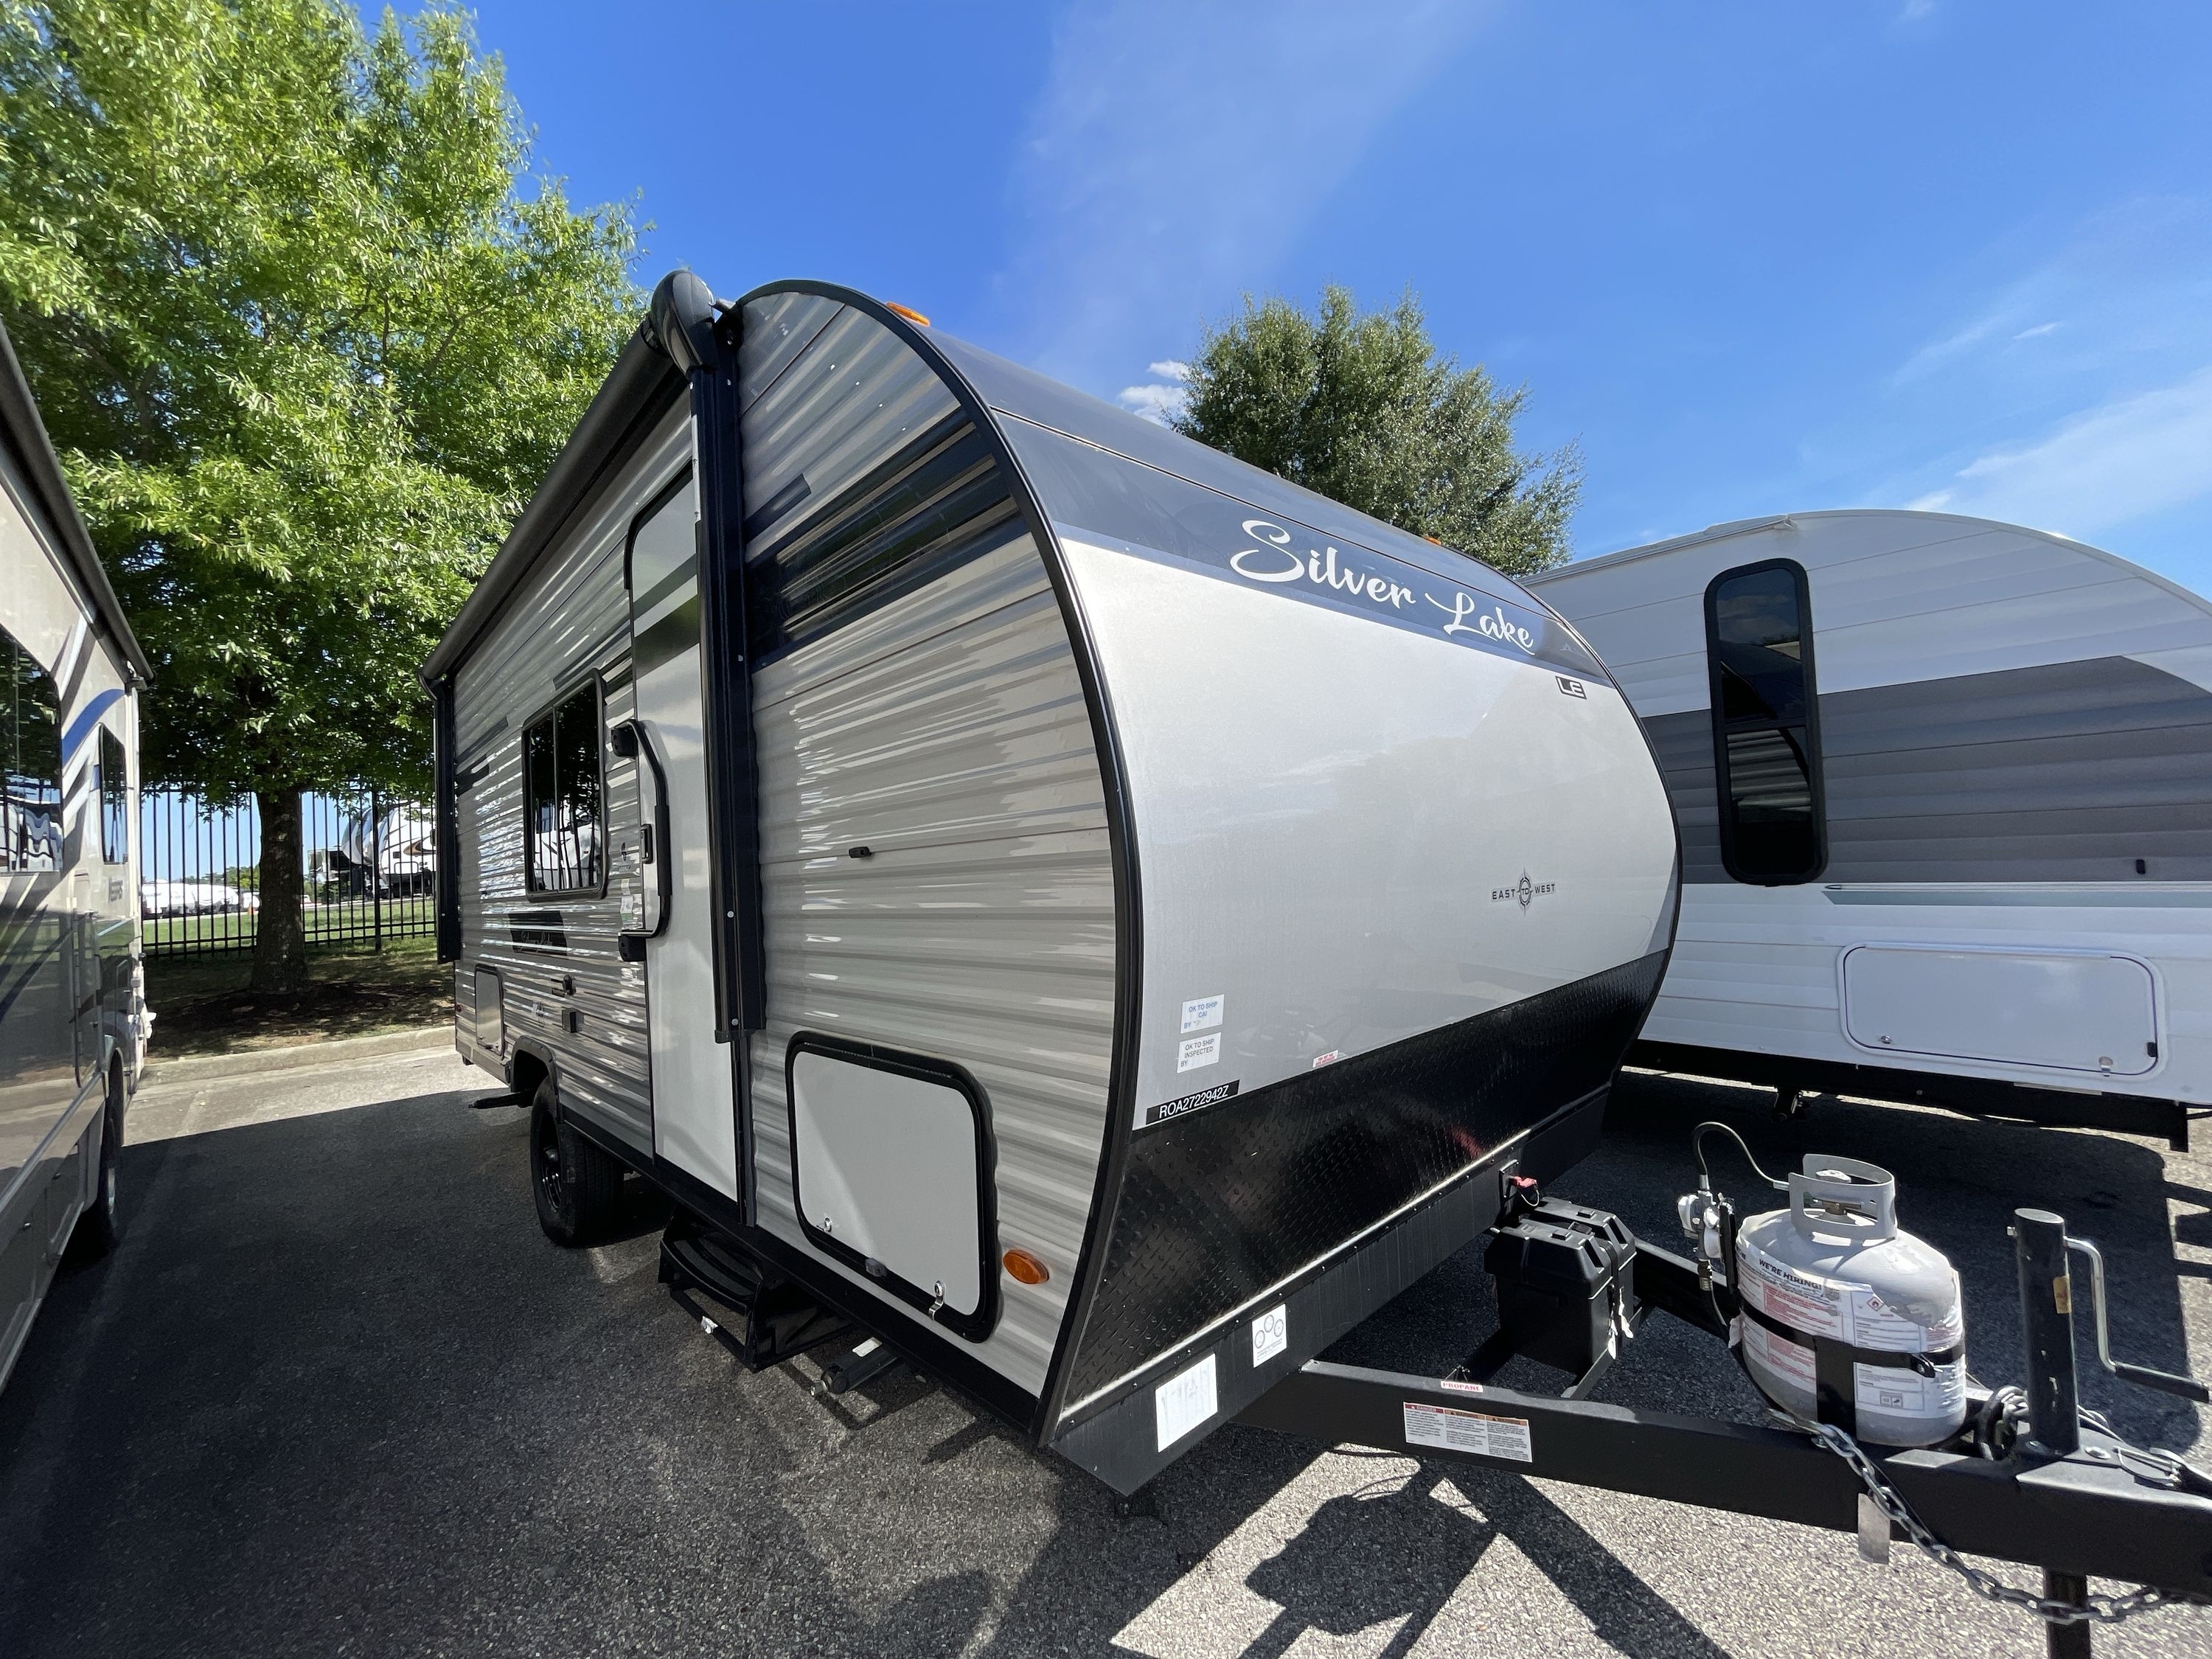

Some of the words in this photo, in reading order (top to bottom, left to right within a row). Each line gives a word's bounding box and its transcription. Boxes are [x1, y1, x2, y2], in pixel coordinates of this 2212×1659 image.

[1229, 519, 1416, 608] Silver
[1425, 591, 1535, 655] Lake
[1556, 677, 1585, 698] LE
[1492, 888, 1516, 900] EAST
[1534, 883, 1556, 894] WEST
[1189, 1005, 1197, 1013] OK
[1202, 1038, 1214, 1046] SHIP
[1184, 1046, 1214, 1059] INSPECTED
[1759, 1258, 1782, 1276] WE'RE
[1783, 1271, 1822, 1290] HIRING!
[1442, 1381, 1481, 1391] PROPANE
